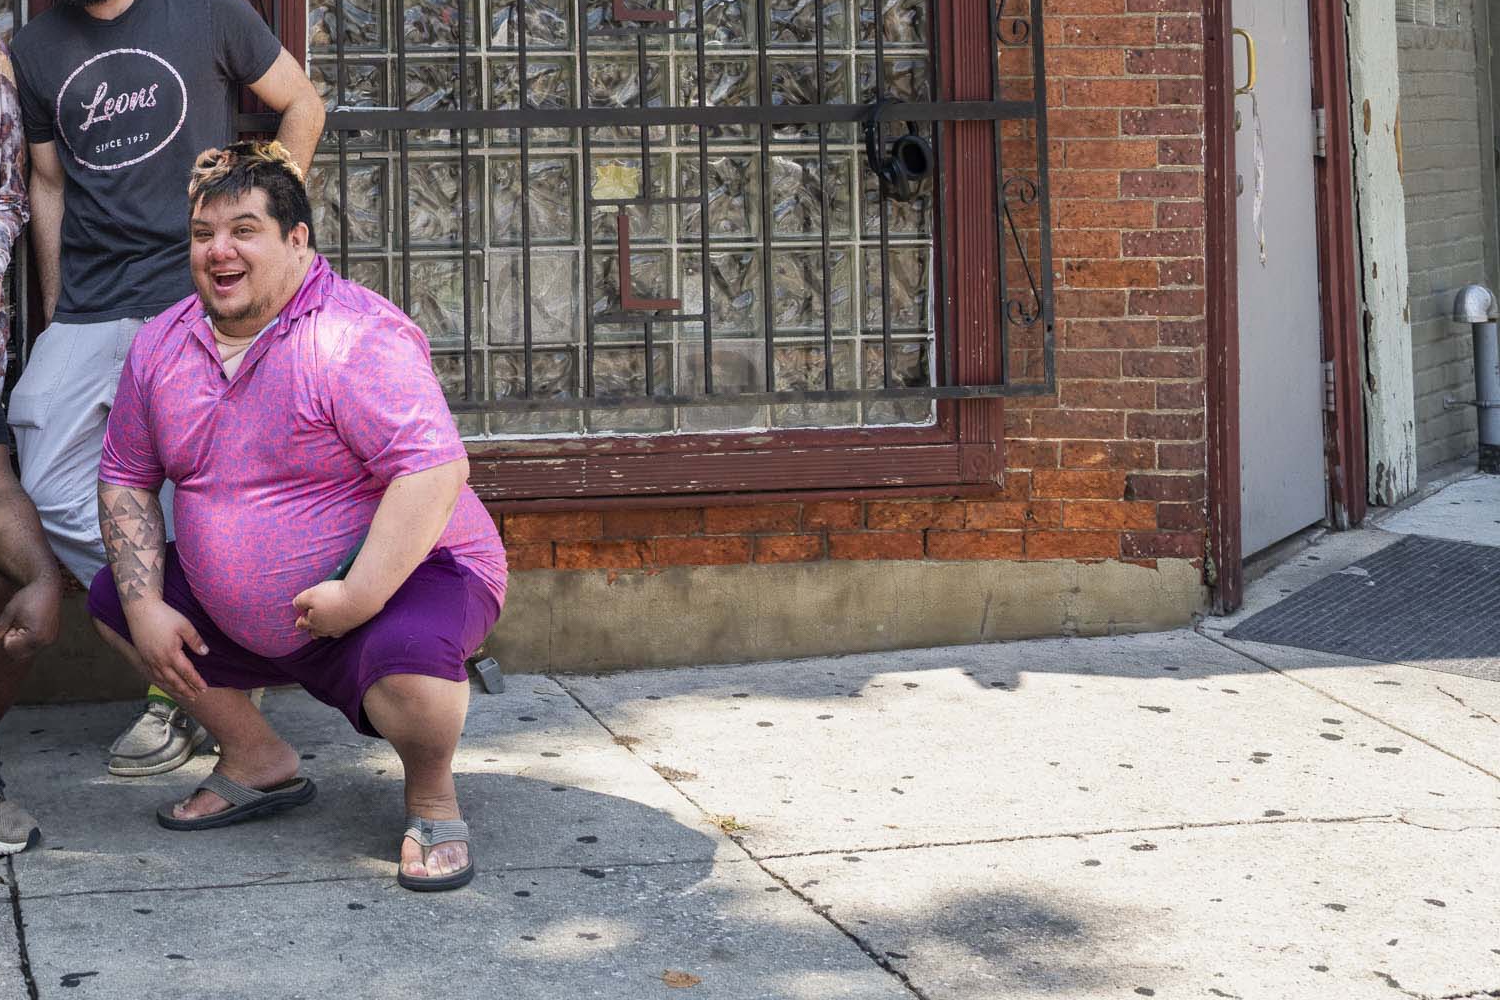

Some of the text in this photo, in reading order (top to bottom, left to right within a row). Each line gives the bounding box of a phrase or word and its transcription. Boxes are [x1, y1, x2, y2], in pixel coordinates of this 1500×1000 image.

[79, 81, 159, 131] Leons
[95, 132, 150, 153] SINCE 1957
